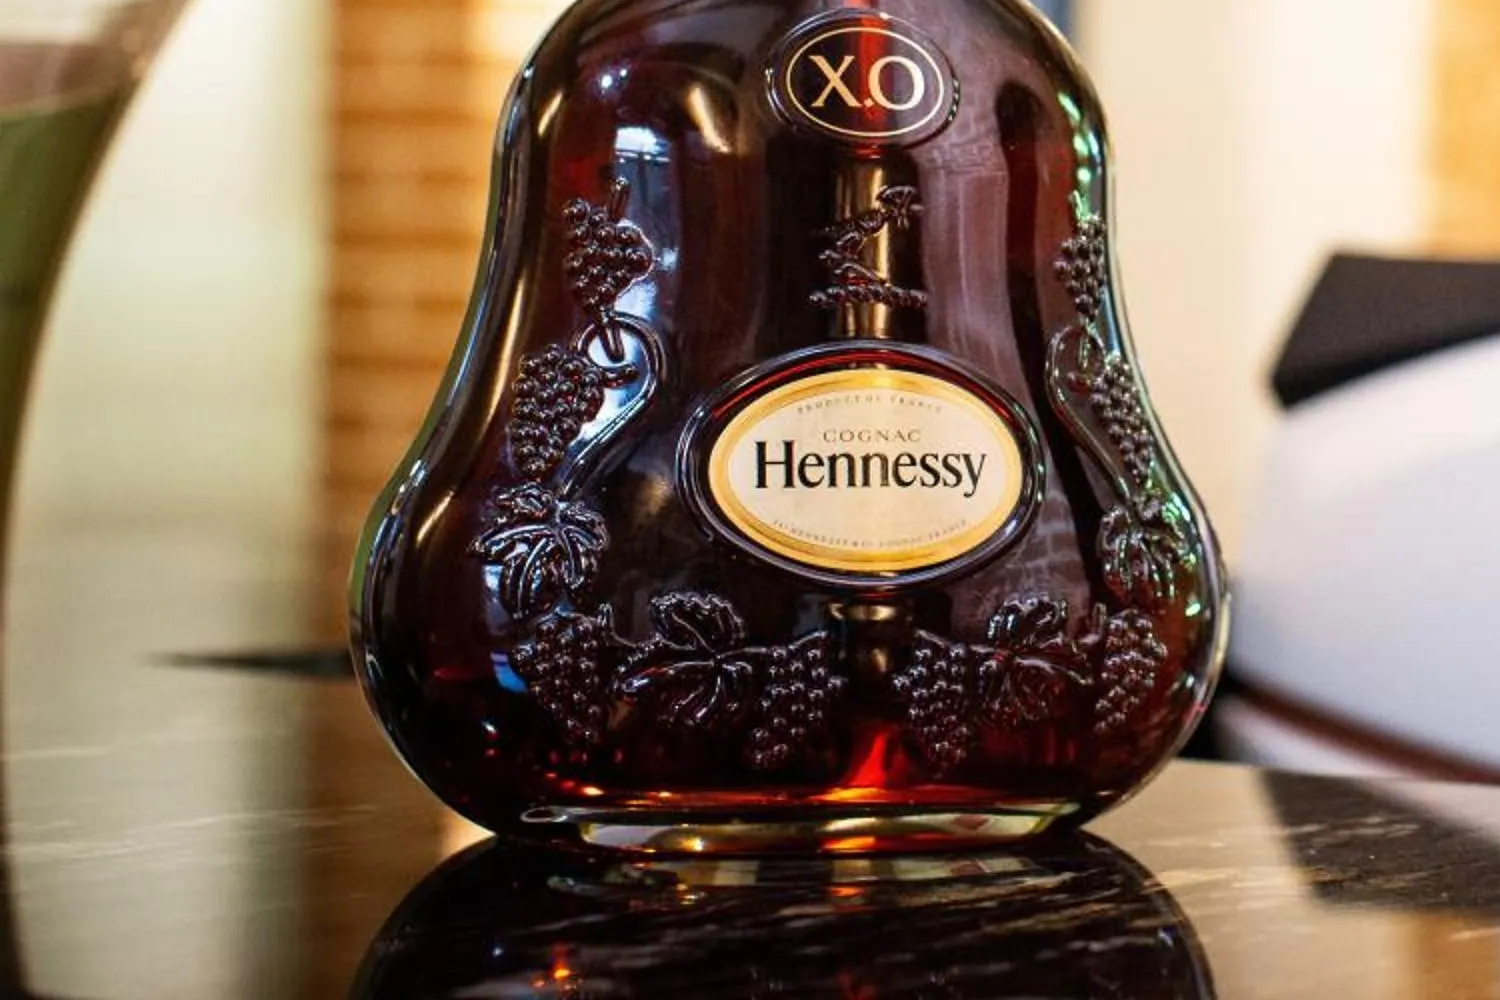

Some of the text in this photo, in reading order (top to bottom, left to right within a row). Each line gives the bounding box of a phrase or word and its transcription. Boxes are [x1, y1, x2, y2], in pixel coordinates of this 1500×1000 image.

[808, 54, 926, 111] X.O
[823, 428, 922, 443] COGNAC
[754, 440, 987, 499] Hennessy
